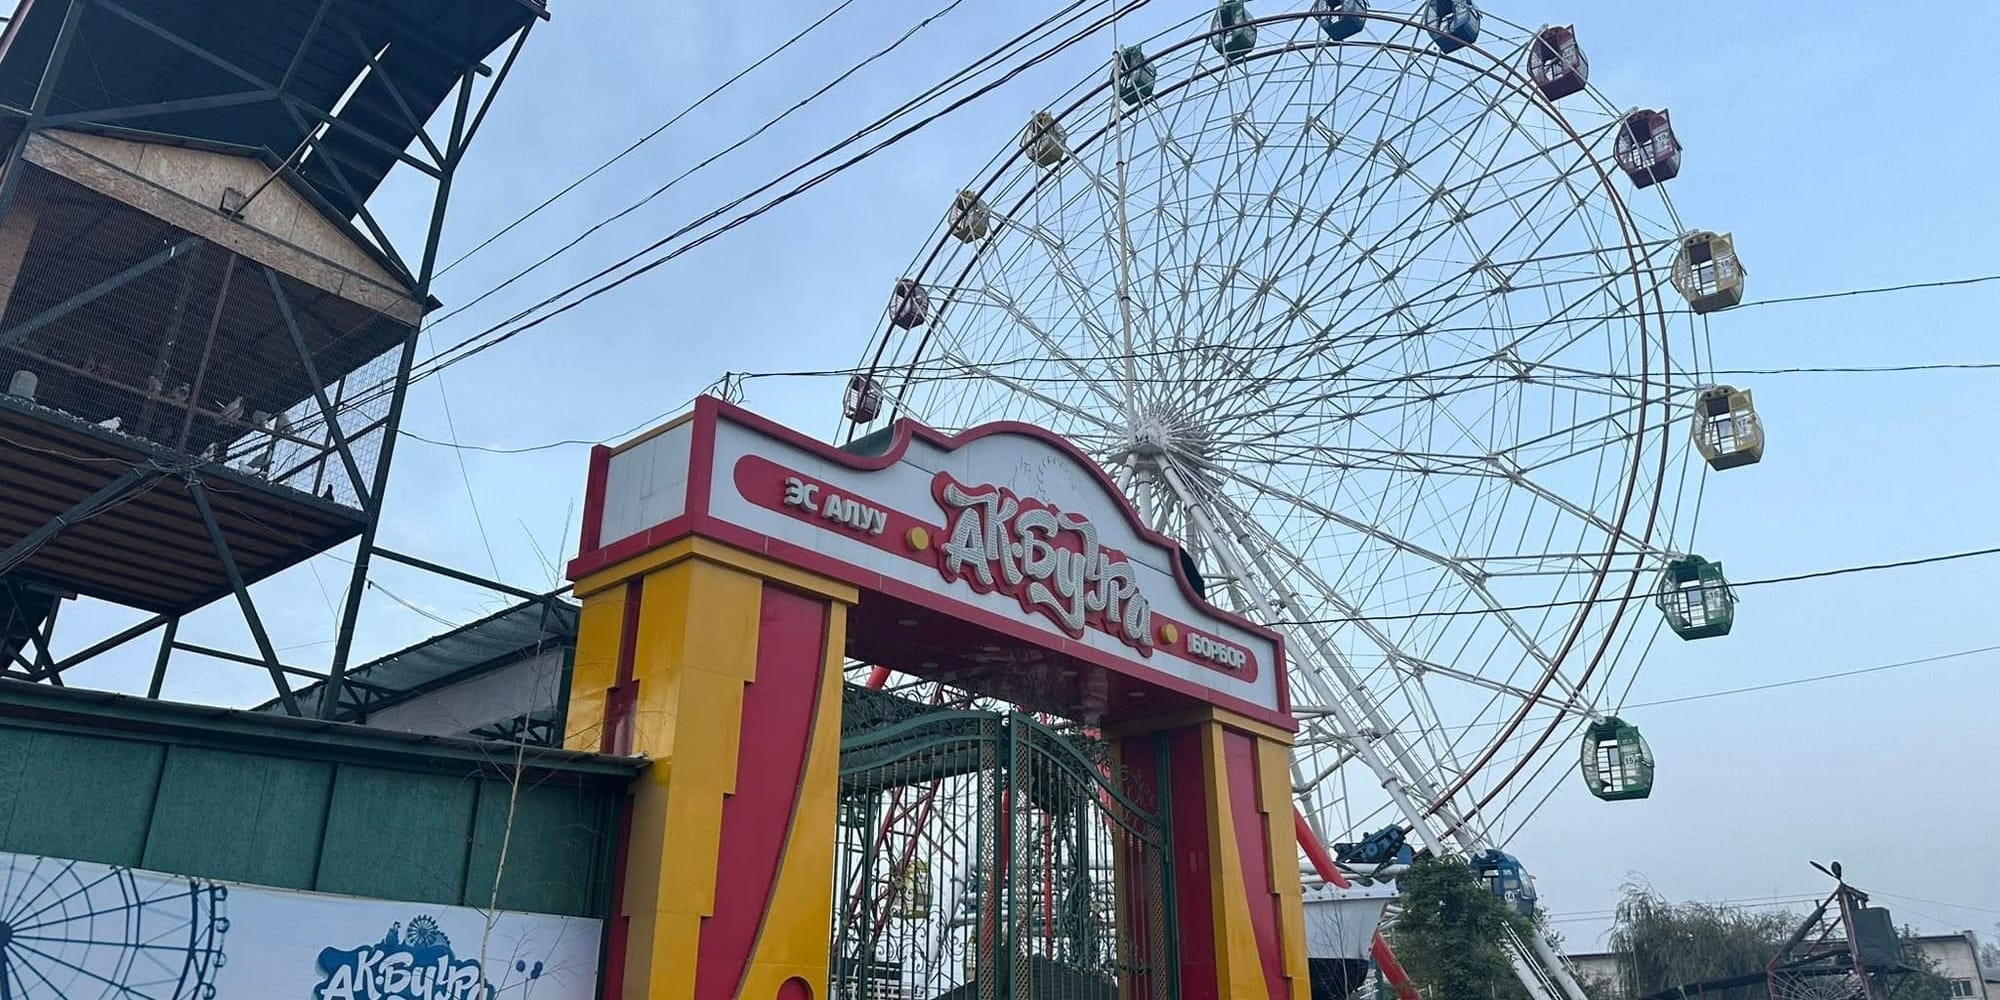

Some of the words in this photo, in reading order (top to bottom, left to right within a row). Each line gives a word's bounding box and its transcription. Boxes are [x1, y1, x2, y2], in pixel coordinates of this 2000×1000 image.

[784, 477, 819, 512] ЭС
[821, 494, 888, 536] АЛУУ
[1187, 633, 1246, 670] БОРБОР
